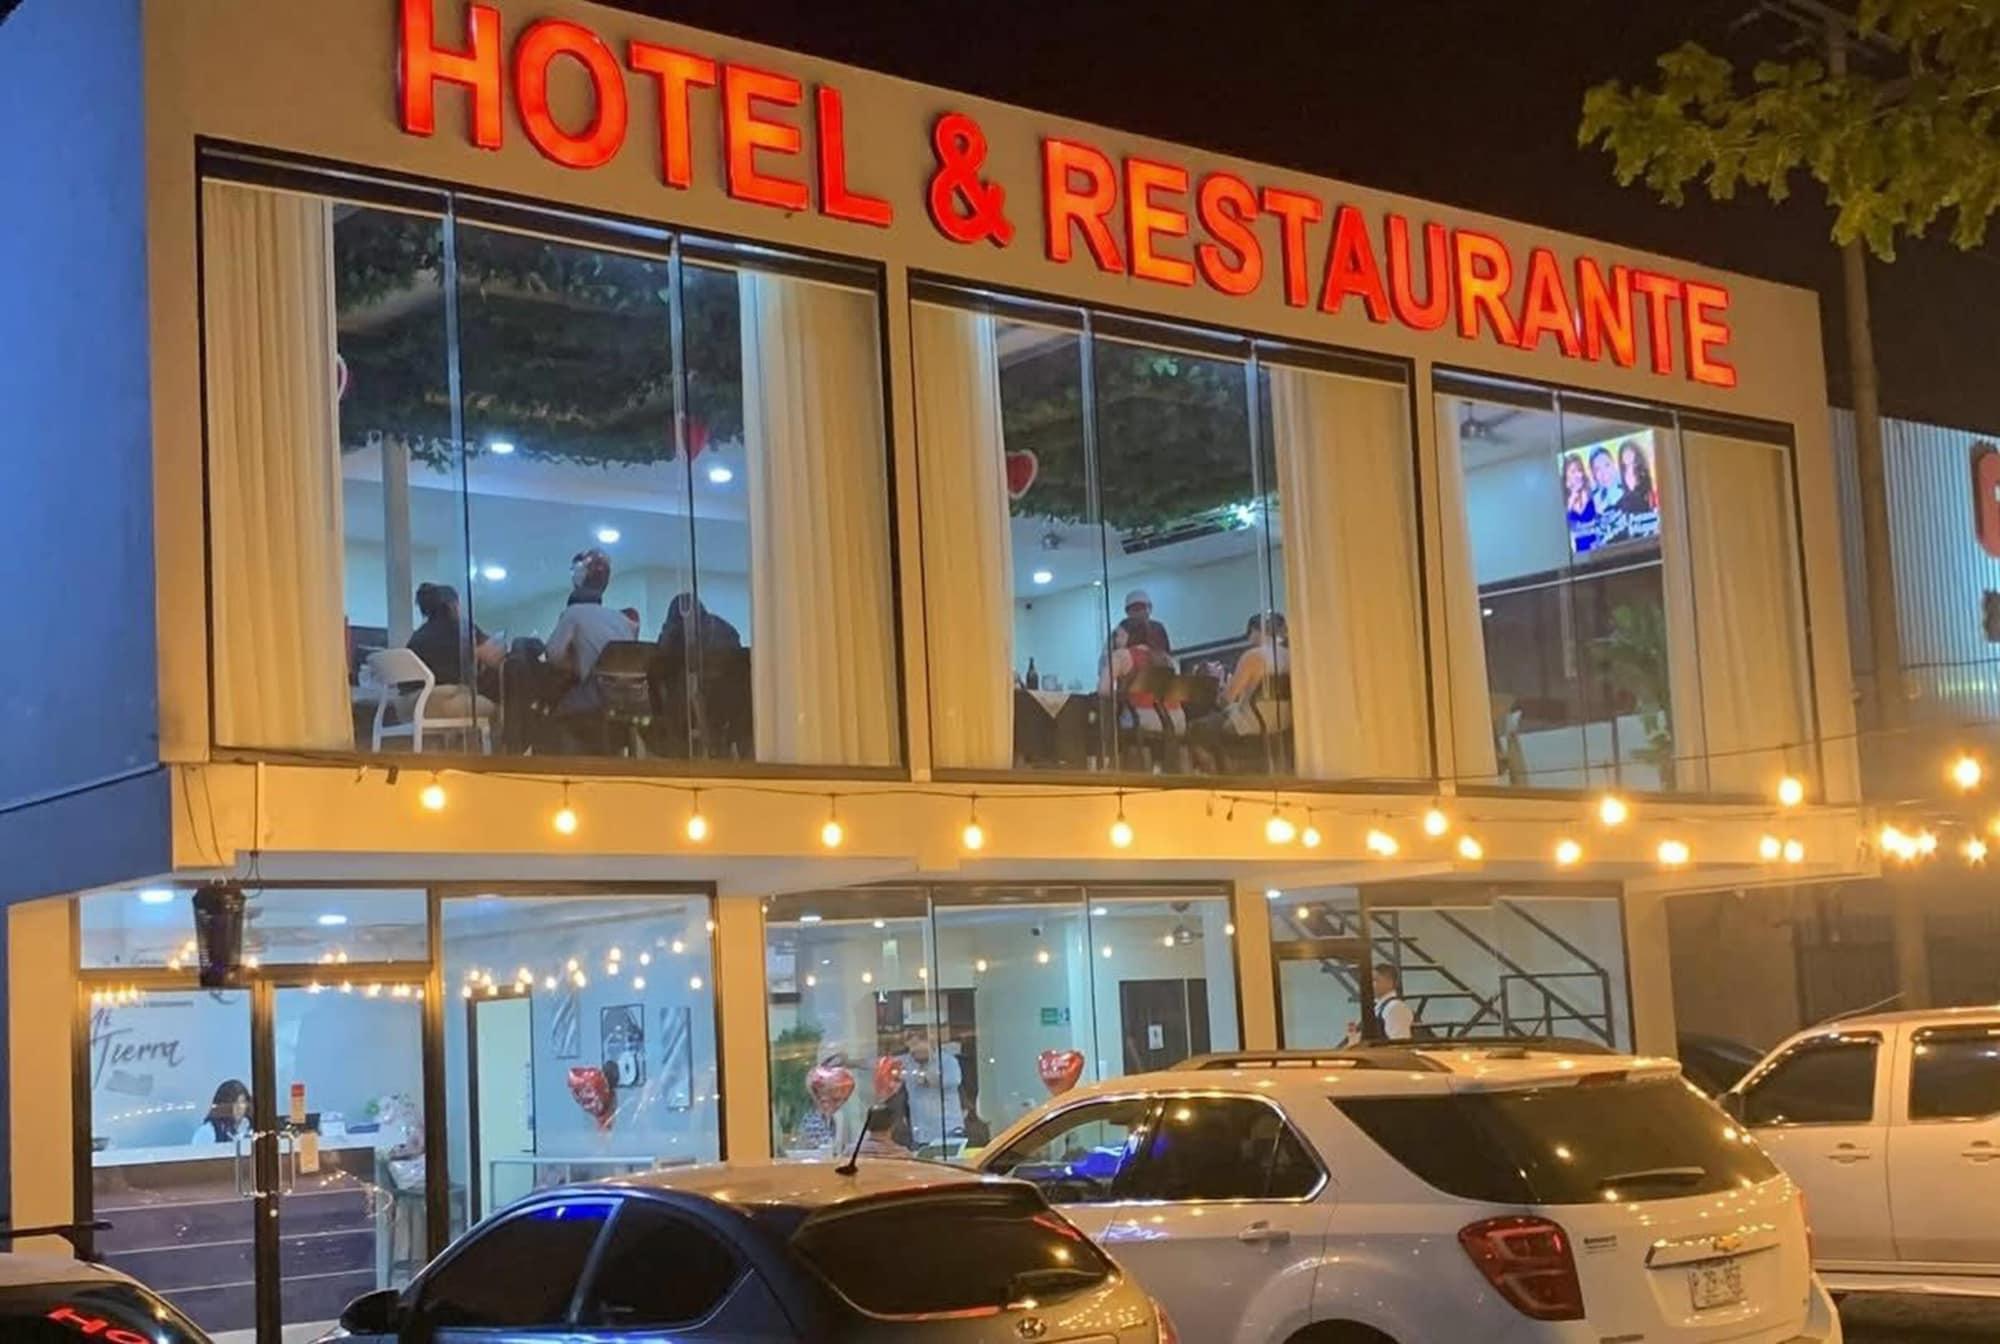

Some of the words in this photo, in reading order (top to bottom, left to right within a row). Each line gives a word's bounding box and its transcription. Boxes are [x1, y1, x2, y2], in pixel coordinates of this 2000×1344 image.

[399, 0, 892, 228] HOTEL
[928, 111, 1014, 247] &
[1042, 137, 1737, 388] RESTAURANTE
[91, 1028, 185, 1089] Tierra
